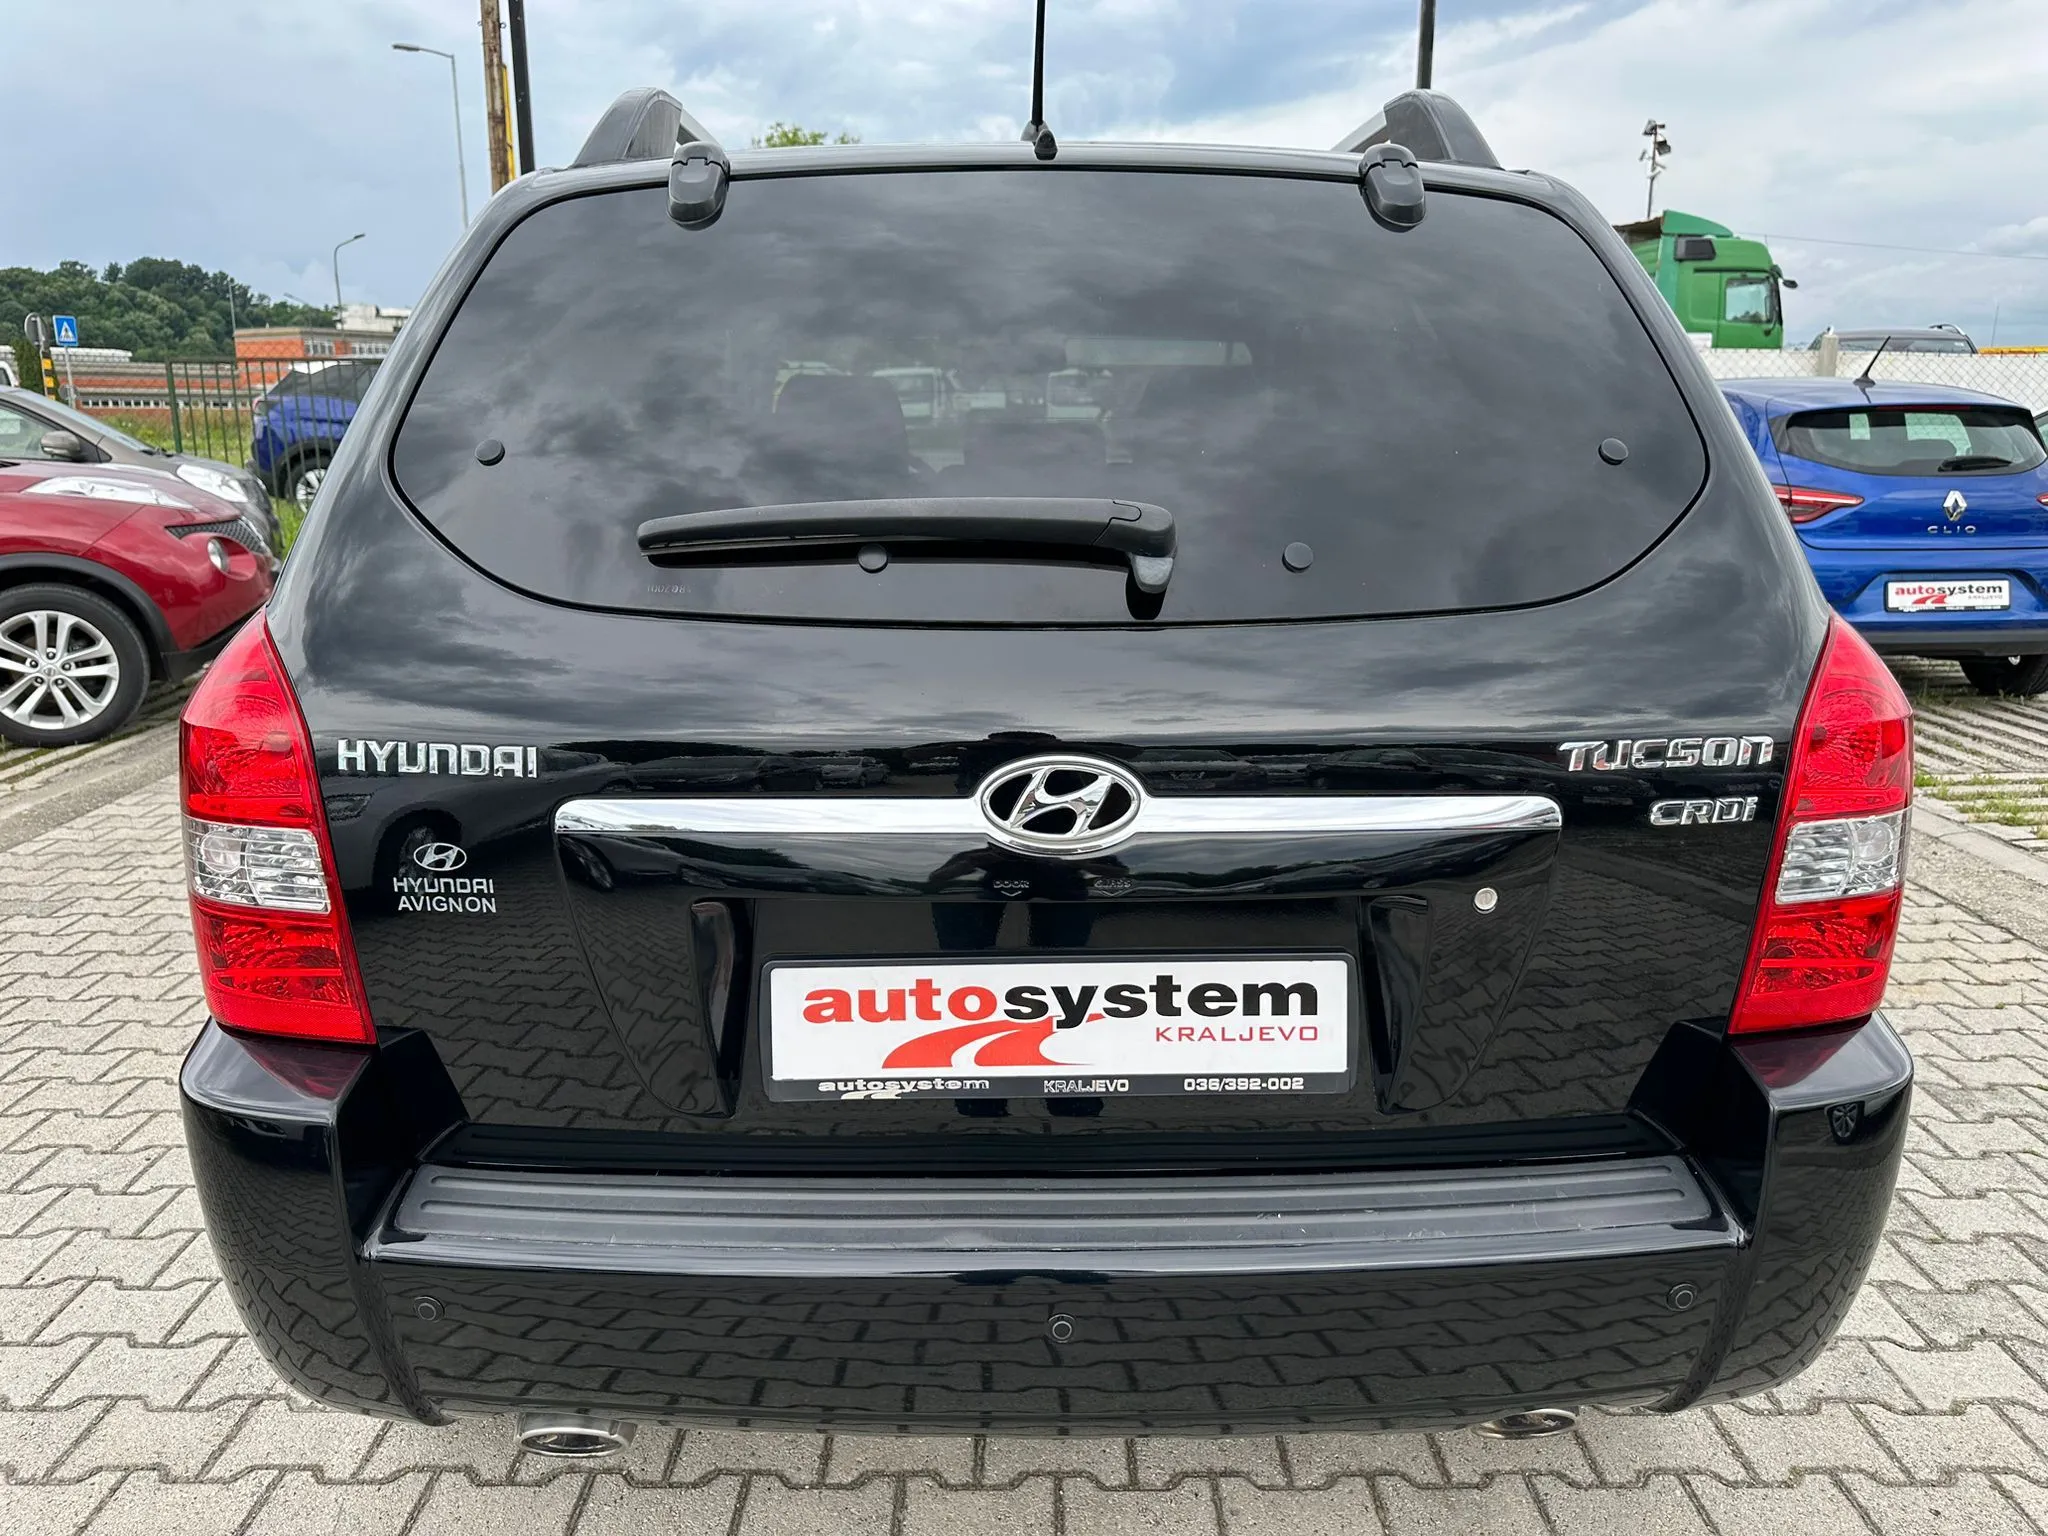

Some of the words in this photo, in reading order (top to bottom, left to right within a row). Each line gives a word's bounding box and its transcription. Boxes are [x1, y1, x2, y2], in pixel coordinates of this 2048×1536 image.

[1927, 525, 1976, 533] CLIO
[1895, 584, 2002, 597] autosystem
[337, 738, 538, 779] HYUNDAI
[1557, 735, 1774, 772] TUCSON
[394, 877, 495, 893] HYUNDAI
[993, 879, 1030, 888] DOOR
[398, 896, 496, 913] AVIGNON
[803, 975, 1318, 1029] autosystem
[1156, 1026, 1318, 1042] KRALJEVO
[818, 1077, 990, 1092] autosystem
[1044, 1079, 1129, 1092] KRALJEVO
[1184, 1077, 1304, 1091] 036/392-002
